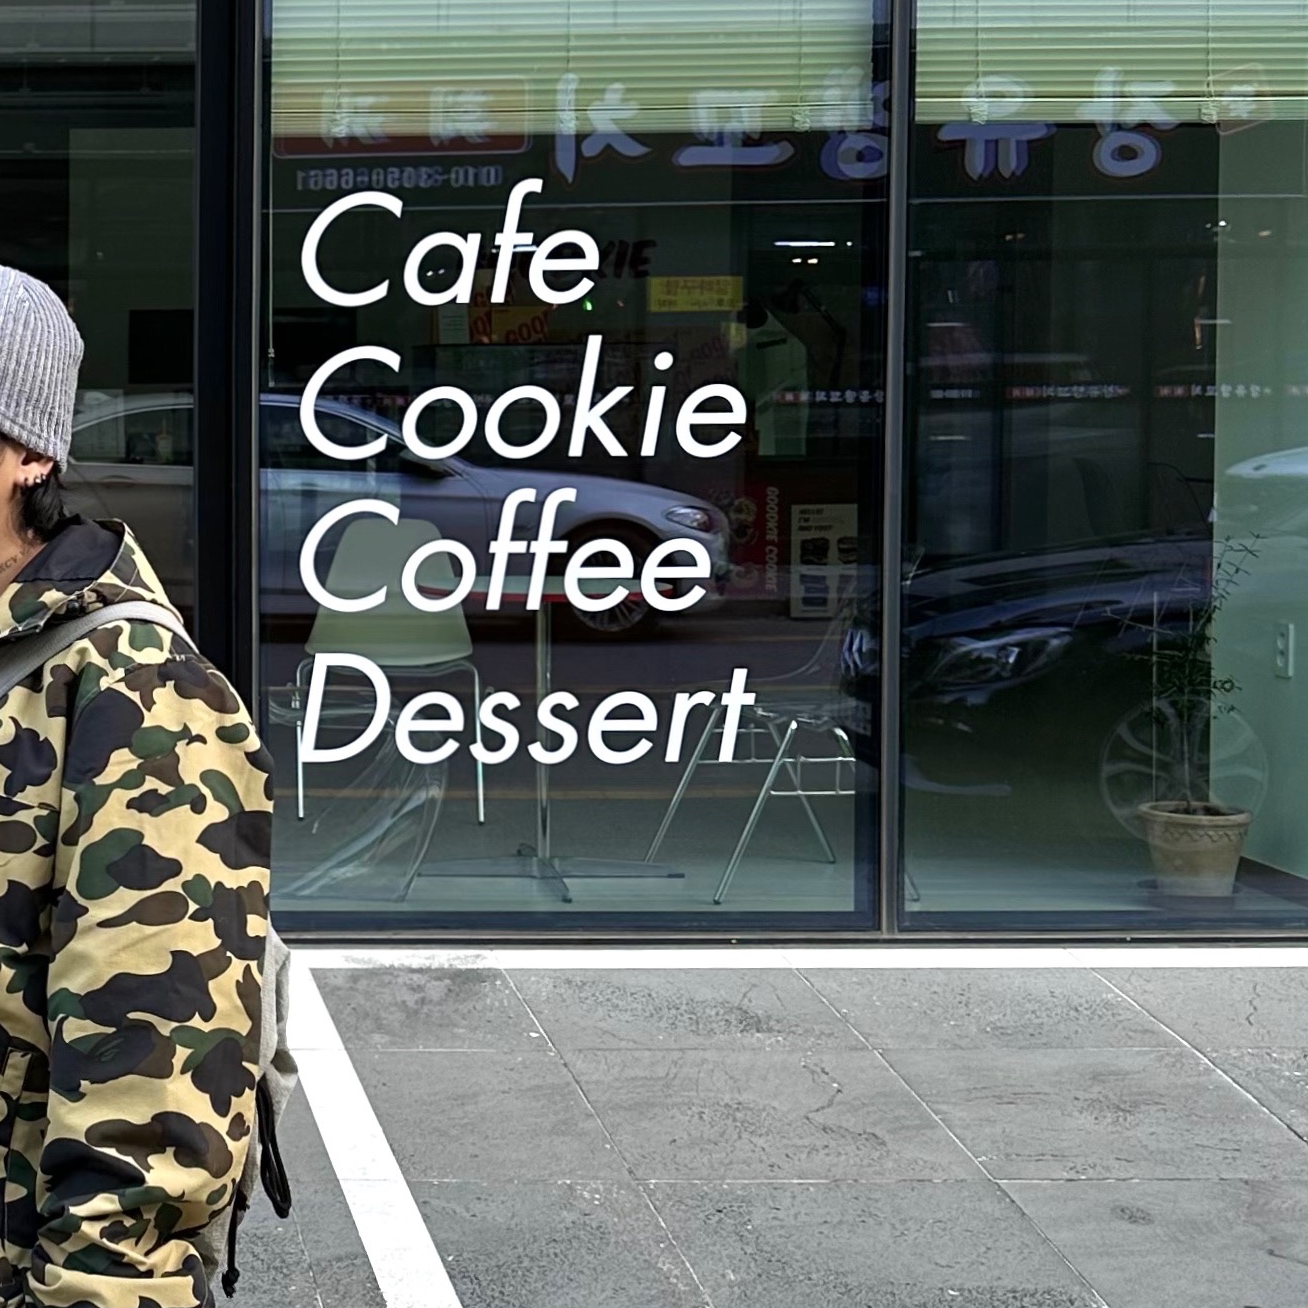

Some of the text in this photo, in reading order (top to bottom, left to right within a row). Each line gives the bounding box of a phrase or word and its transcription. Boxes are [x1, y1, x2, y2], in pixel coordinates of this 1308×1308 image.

[301, 178, 599, 307] Cafe
[299, 335, 746, 460] Cookie
[299, 488, 711, 612] Coffee
[299, 653, 756, 765] Dessert
